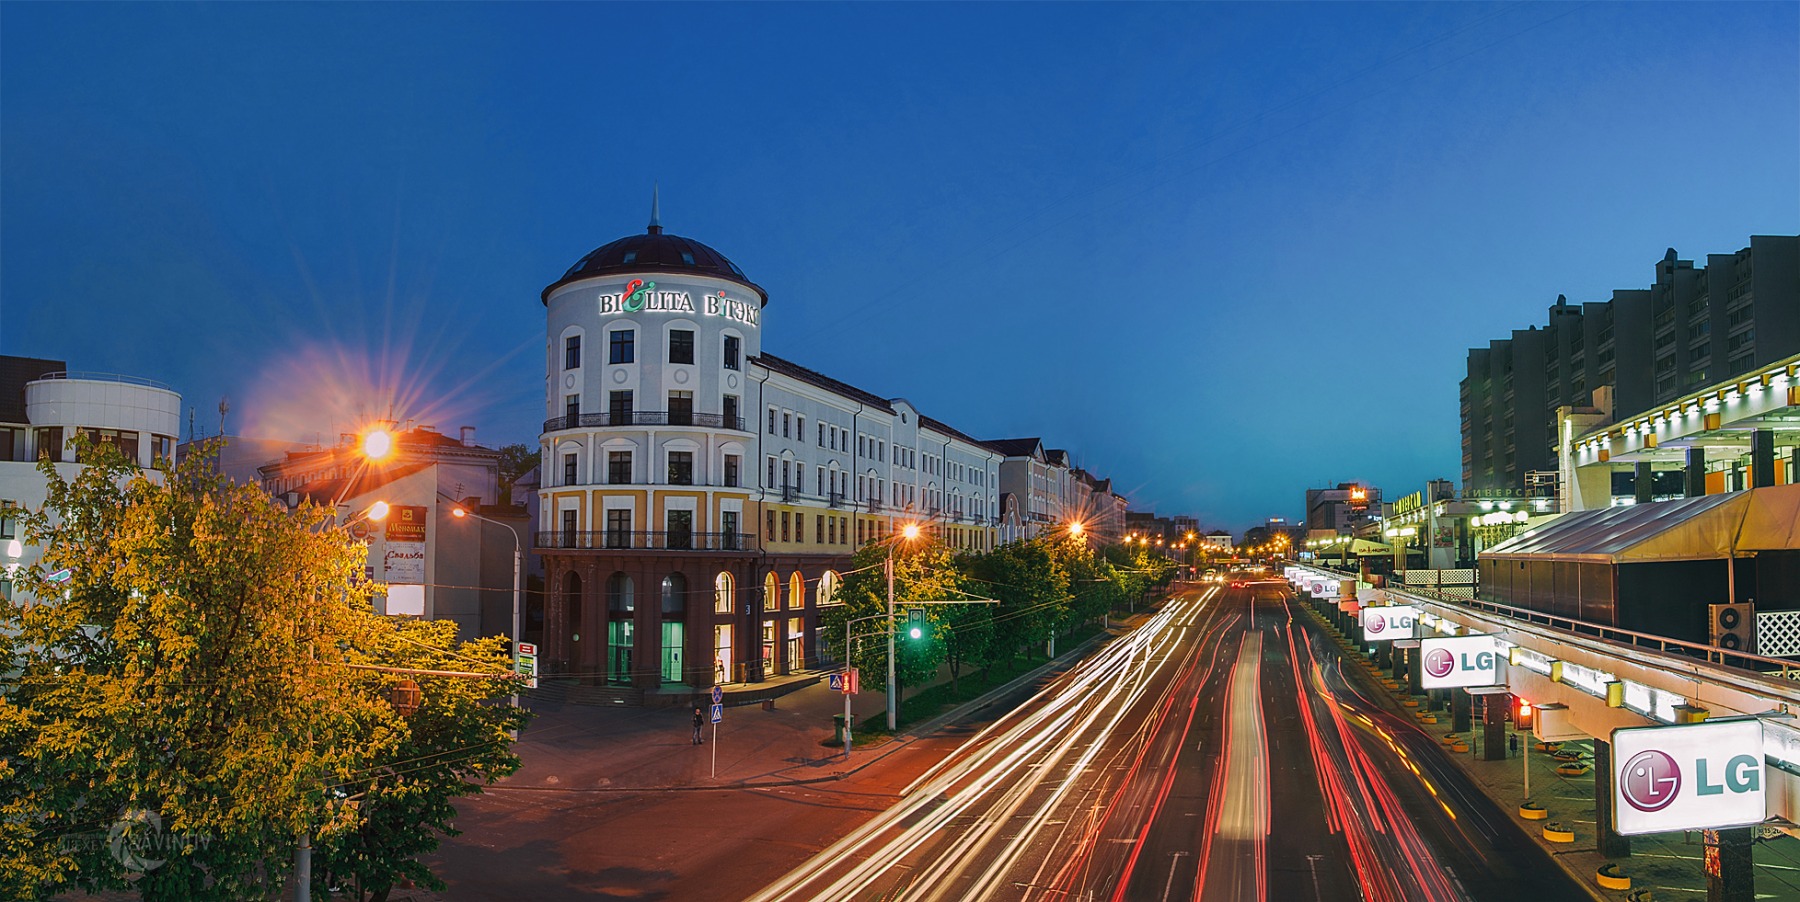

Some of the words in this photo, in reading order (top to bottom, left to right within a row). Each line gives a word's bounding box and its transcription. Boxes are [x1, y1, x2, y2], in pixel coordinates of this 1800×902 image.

[1390, 616, 1411, 629] LG
[1461, 651, 1493, 671] LG
[1695, 754, 1760, 796] LG
